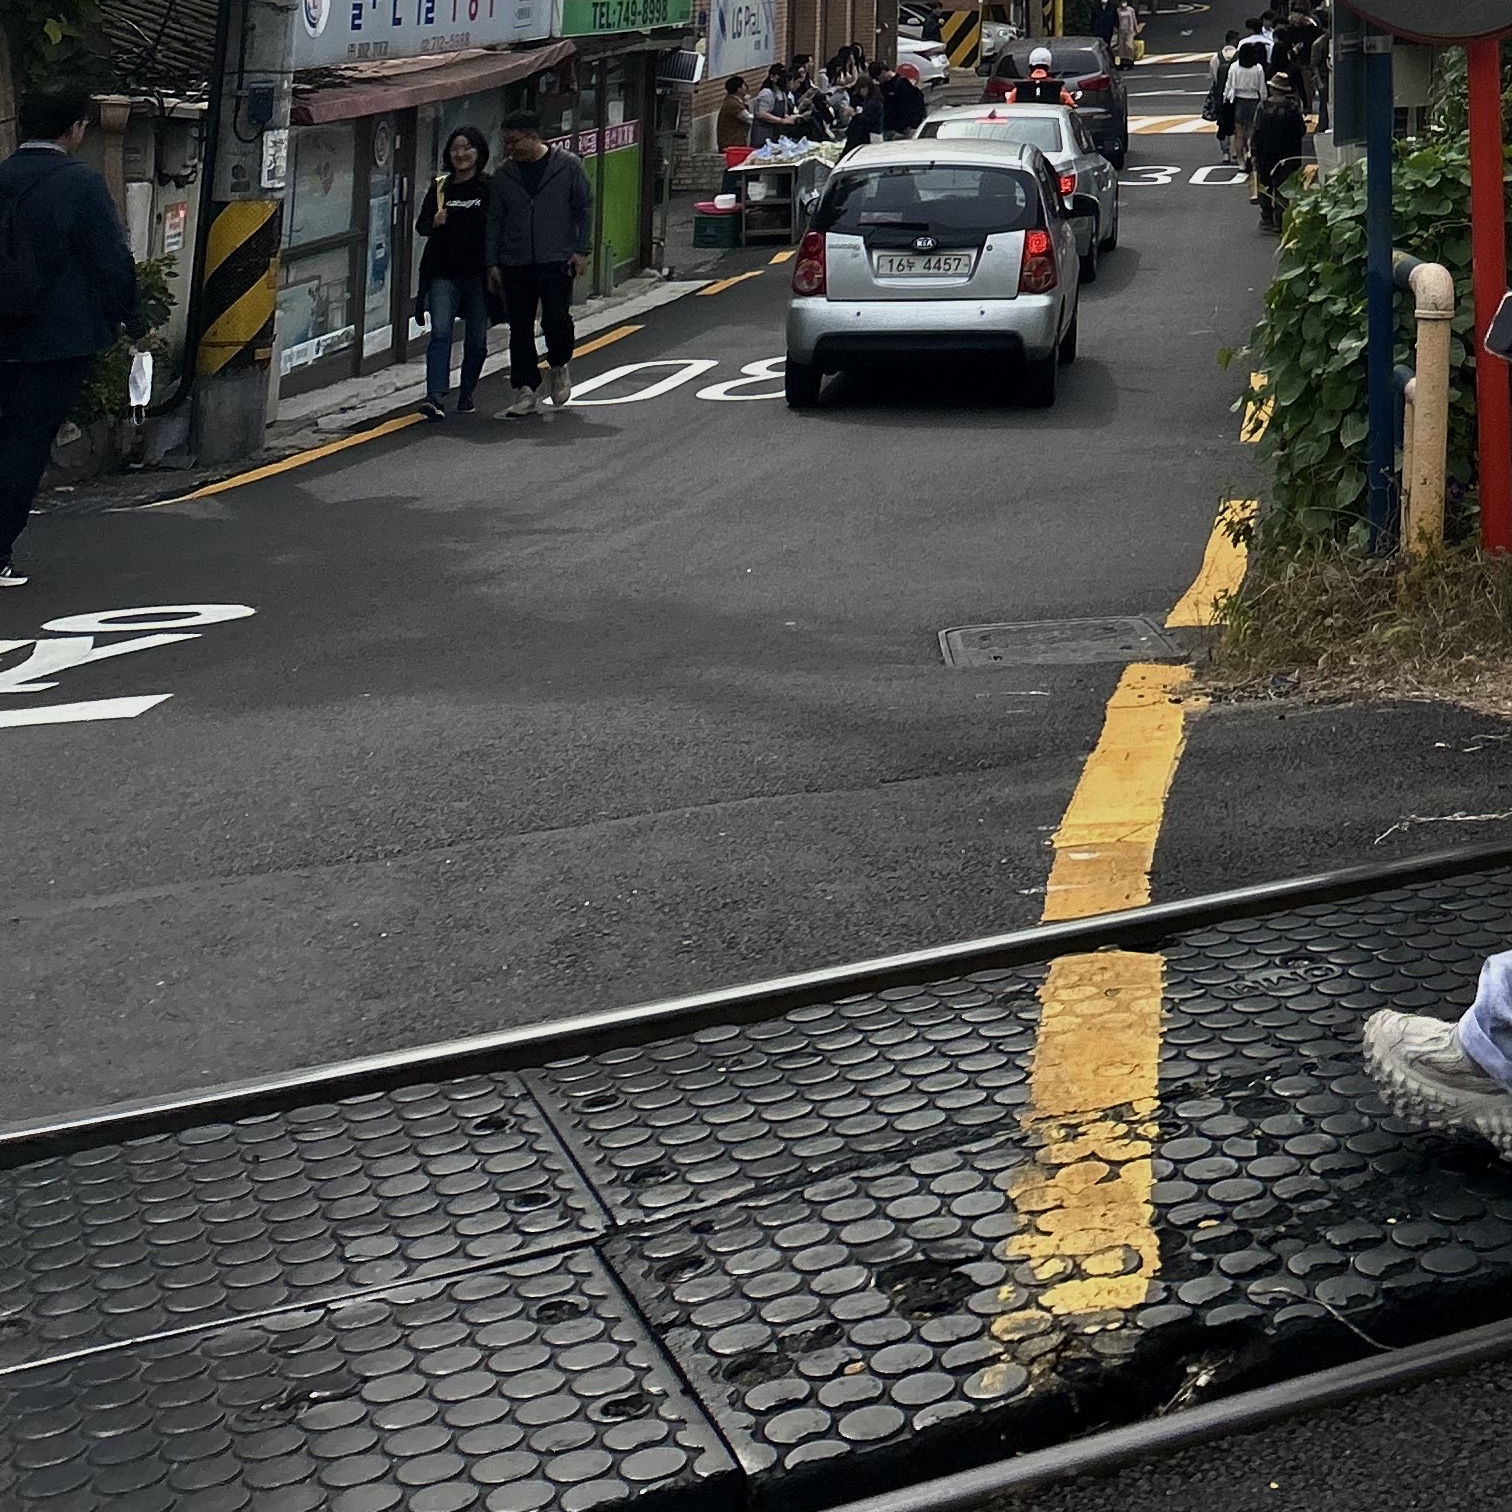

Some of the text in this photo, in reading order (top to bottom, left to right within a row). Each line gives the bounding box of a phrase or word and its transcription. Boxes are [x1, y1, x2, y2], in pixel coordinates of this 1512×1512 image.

[1118, 165, 1250, 186] 30
[916, 237, 933, 247] KIA
[923, 257, 962, 272] 4457
